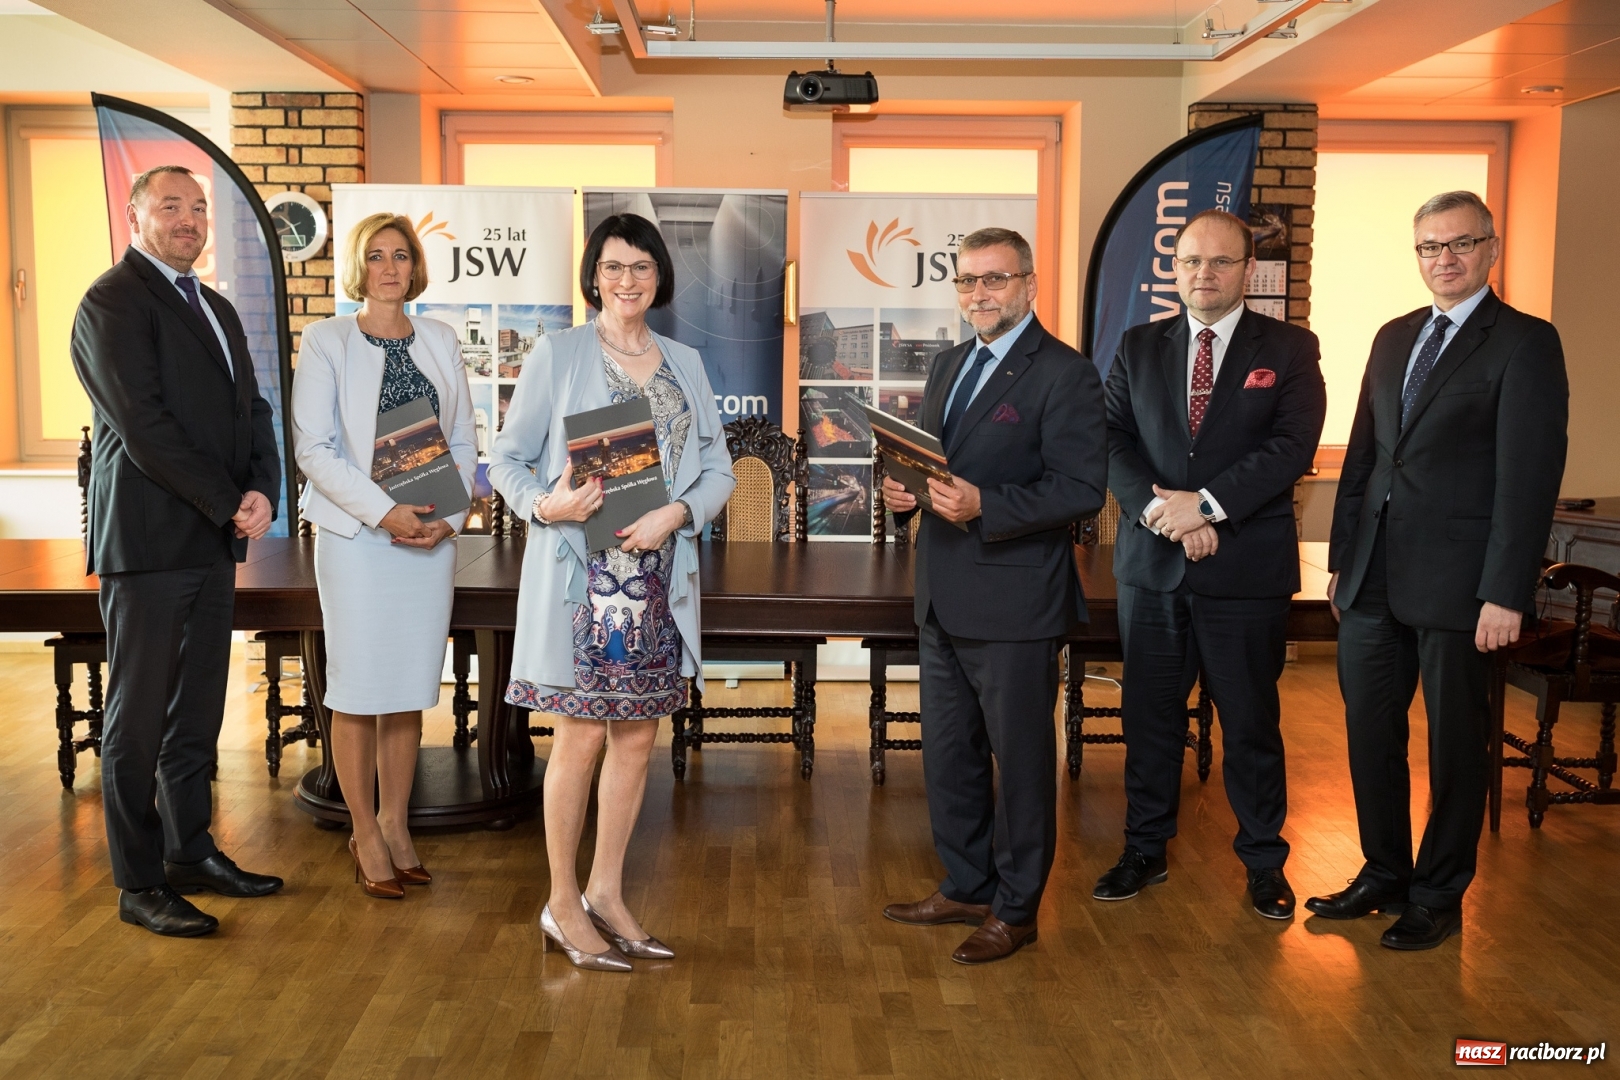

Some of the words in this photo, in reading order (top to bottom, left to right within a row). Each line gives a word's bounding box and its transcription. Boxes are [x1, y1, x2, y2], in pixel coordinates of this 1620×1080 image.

[483, 227, 502, 242] 25
[507, 226, 527, 242] lat
[947, 233, 965, 247] 25
[447, 246, 527, 283] JSW
[911, 251, 959, 288] JS
